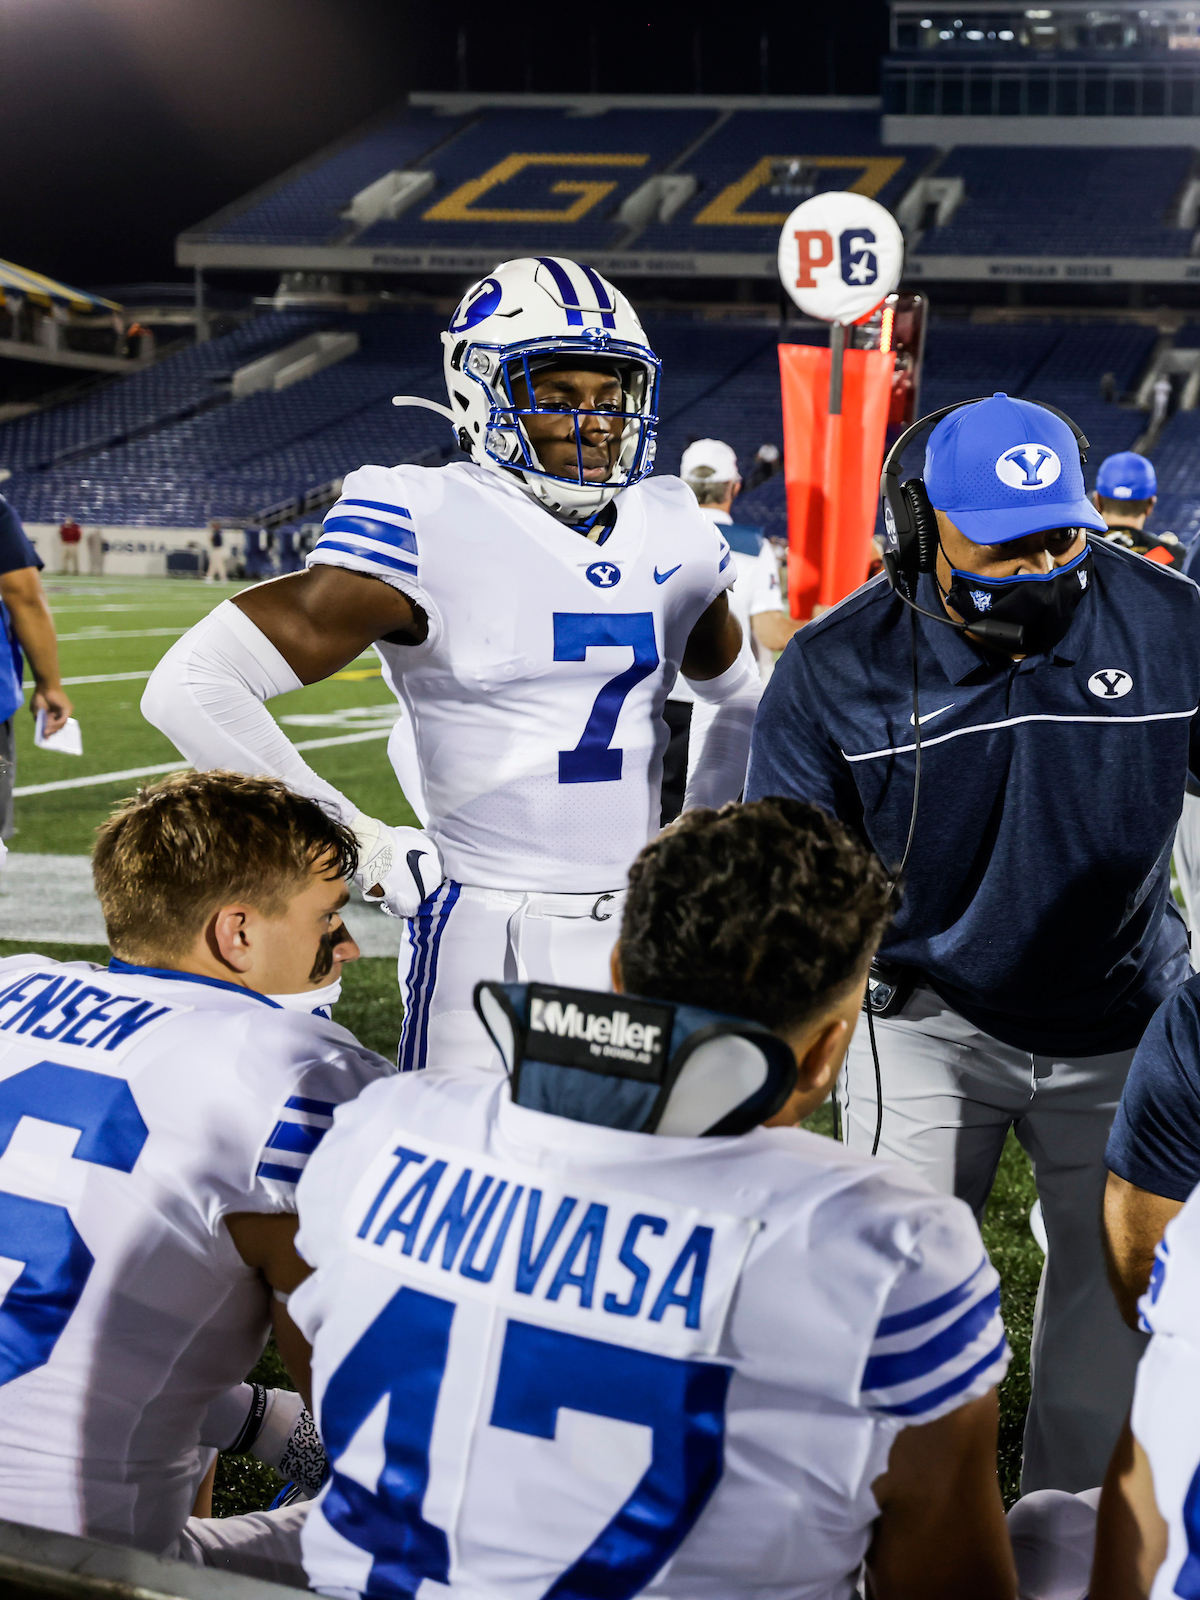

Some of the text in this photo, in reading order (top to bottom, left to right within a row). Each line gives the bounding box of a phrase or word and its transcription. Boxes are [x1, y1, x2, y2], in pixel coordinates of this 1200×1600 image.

[421, 153, 904, 224] GO
[793, 228, 878, 288] P6
[552, 611, 660, 784] 7
[0, 972, 173, 1051] ENSEN
[544, 1000, 661, 1053] Mueller
[356, 1144, 715, 1331] TANUVASA
[320, 1286, 735, 1600] 47
